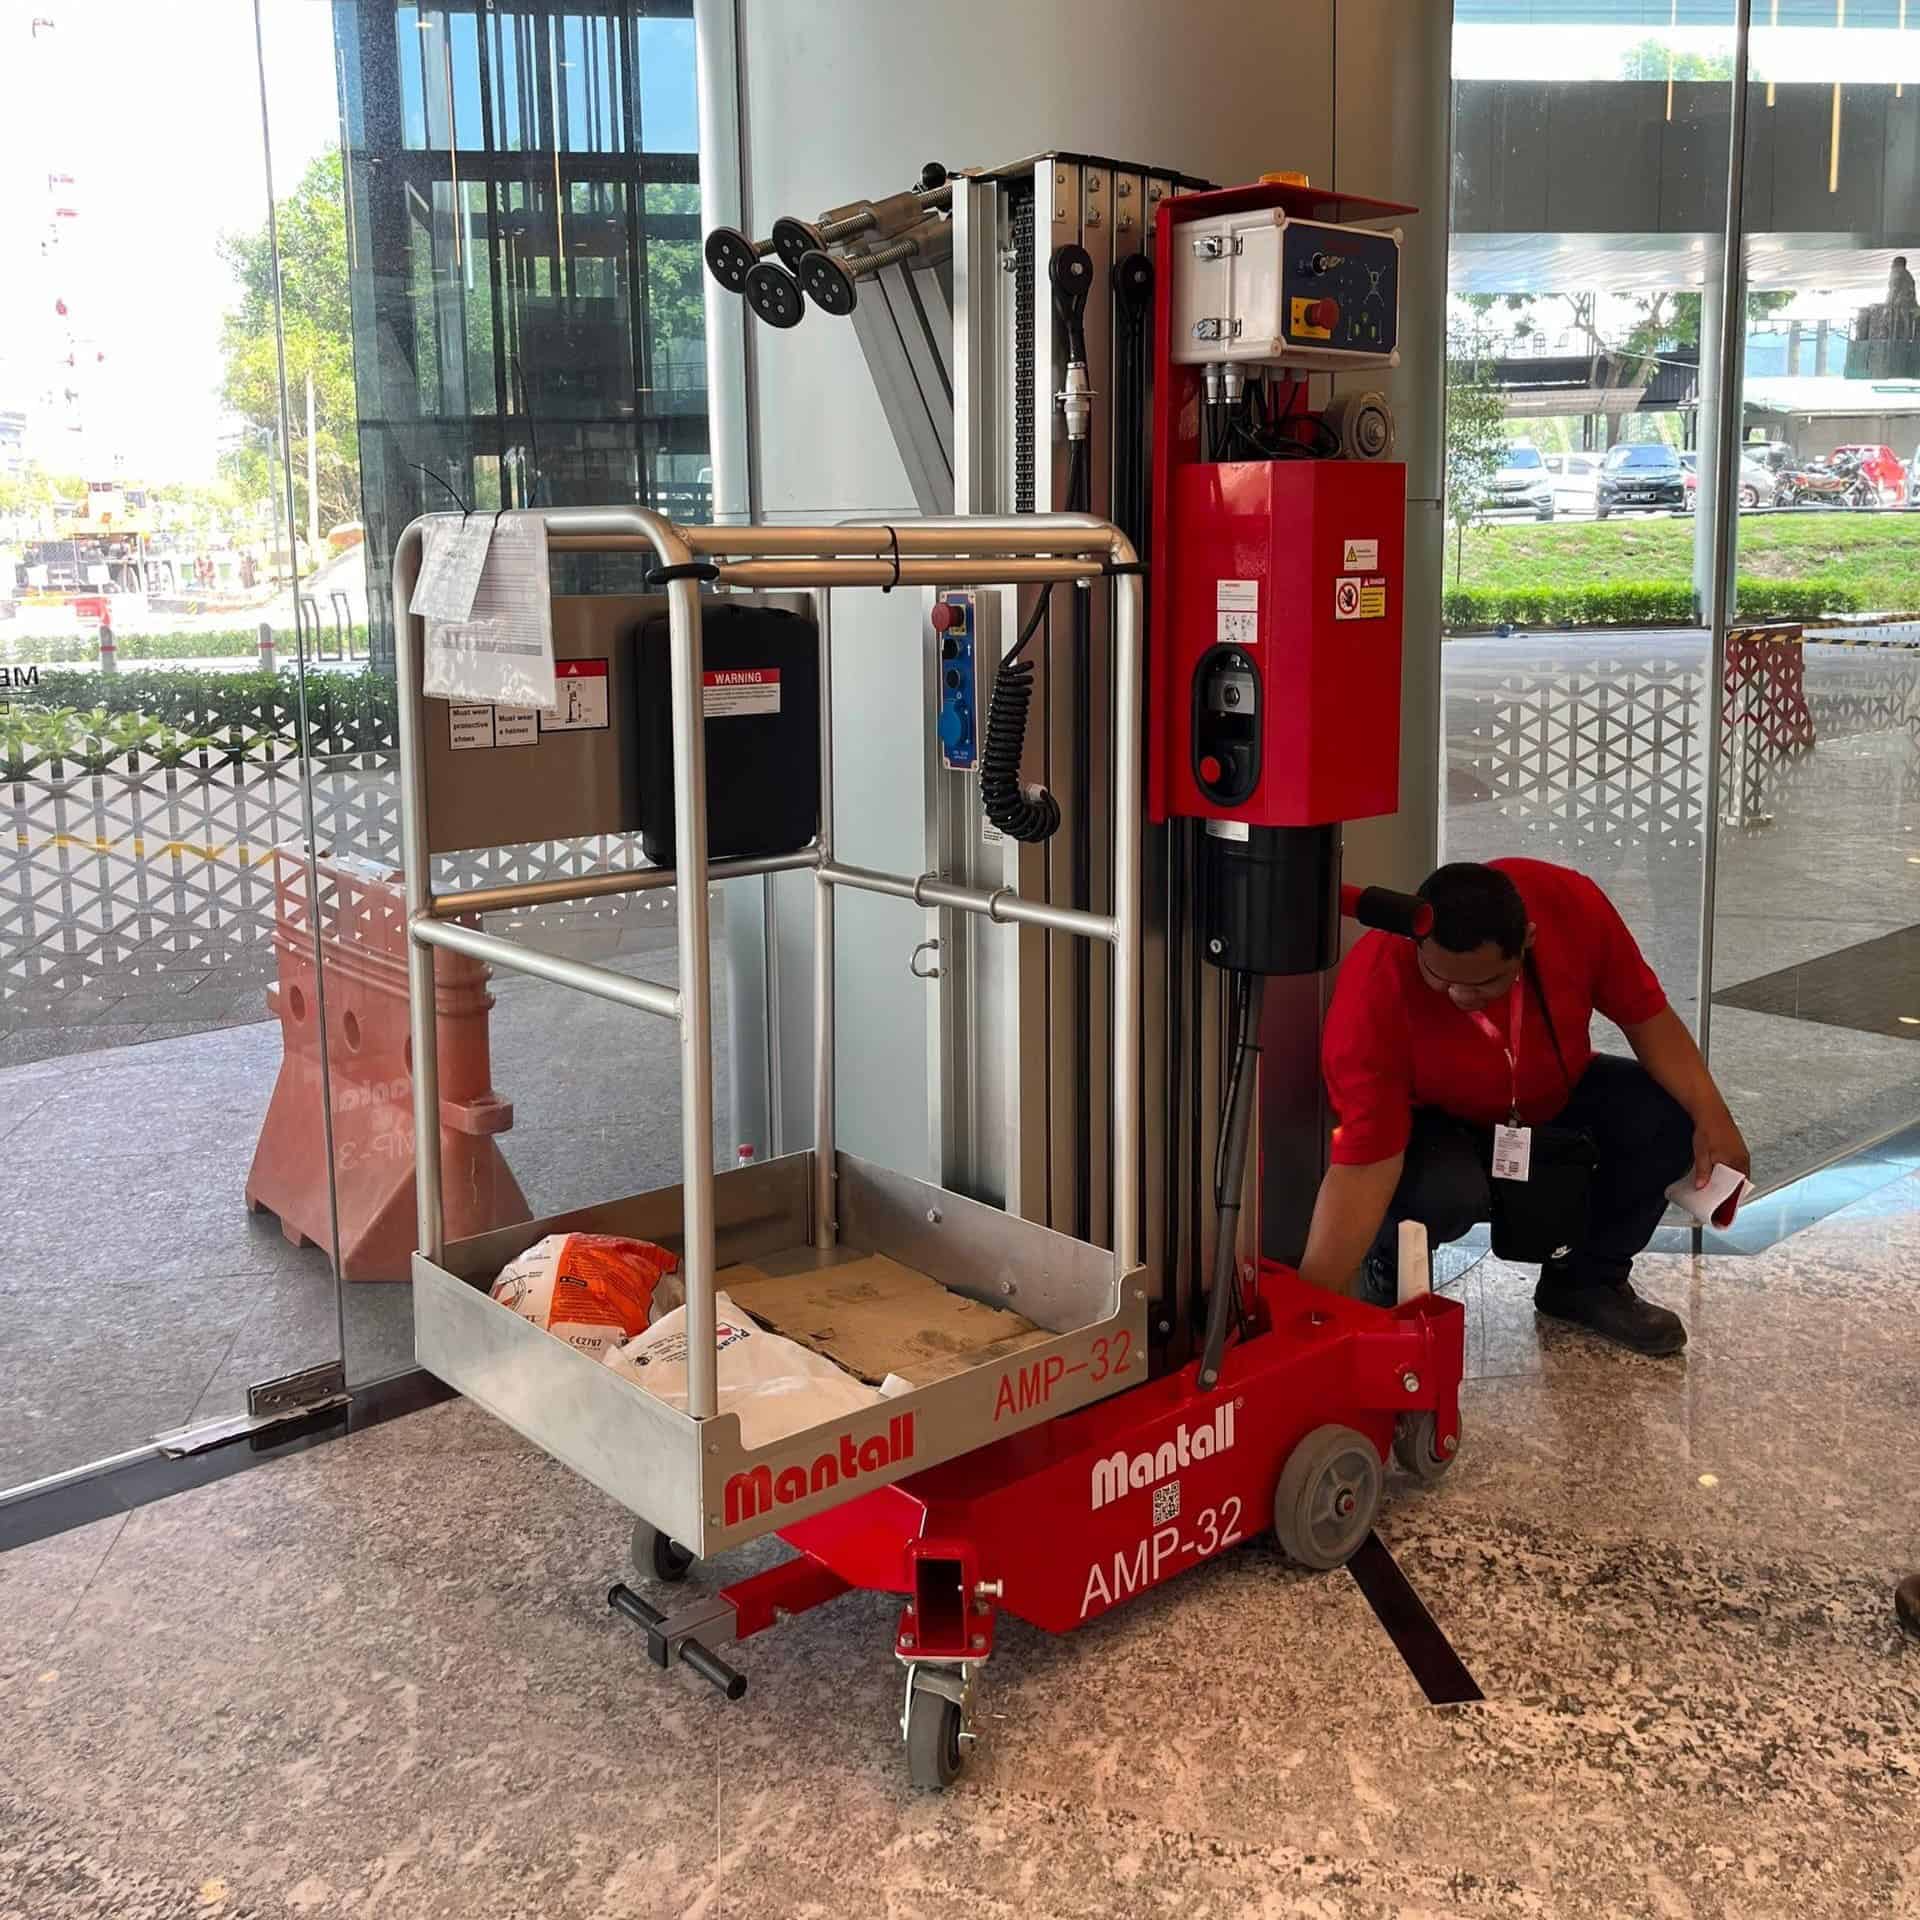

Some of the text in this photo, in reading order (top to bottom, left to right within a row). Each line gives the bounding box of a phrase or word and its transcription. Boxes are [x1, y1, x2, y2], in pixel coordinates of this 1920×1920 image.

[453, 723, 489, 731] protective
[714, 672, 762, 685] WARNING
[993, 1329, 1132, 1422] AMP-32
[724, 1412, 915, 1527] Mantall
[1091, 1400, 1235, 1511] Mantall
[1079, 1496, 1242, 1619] AMP-32
